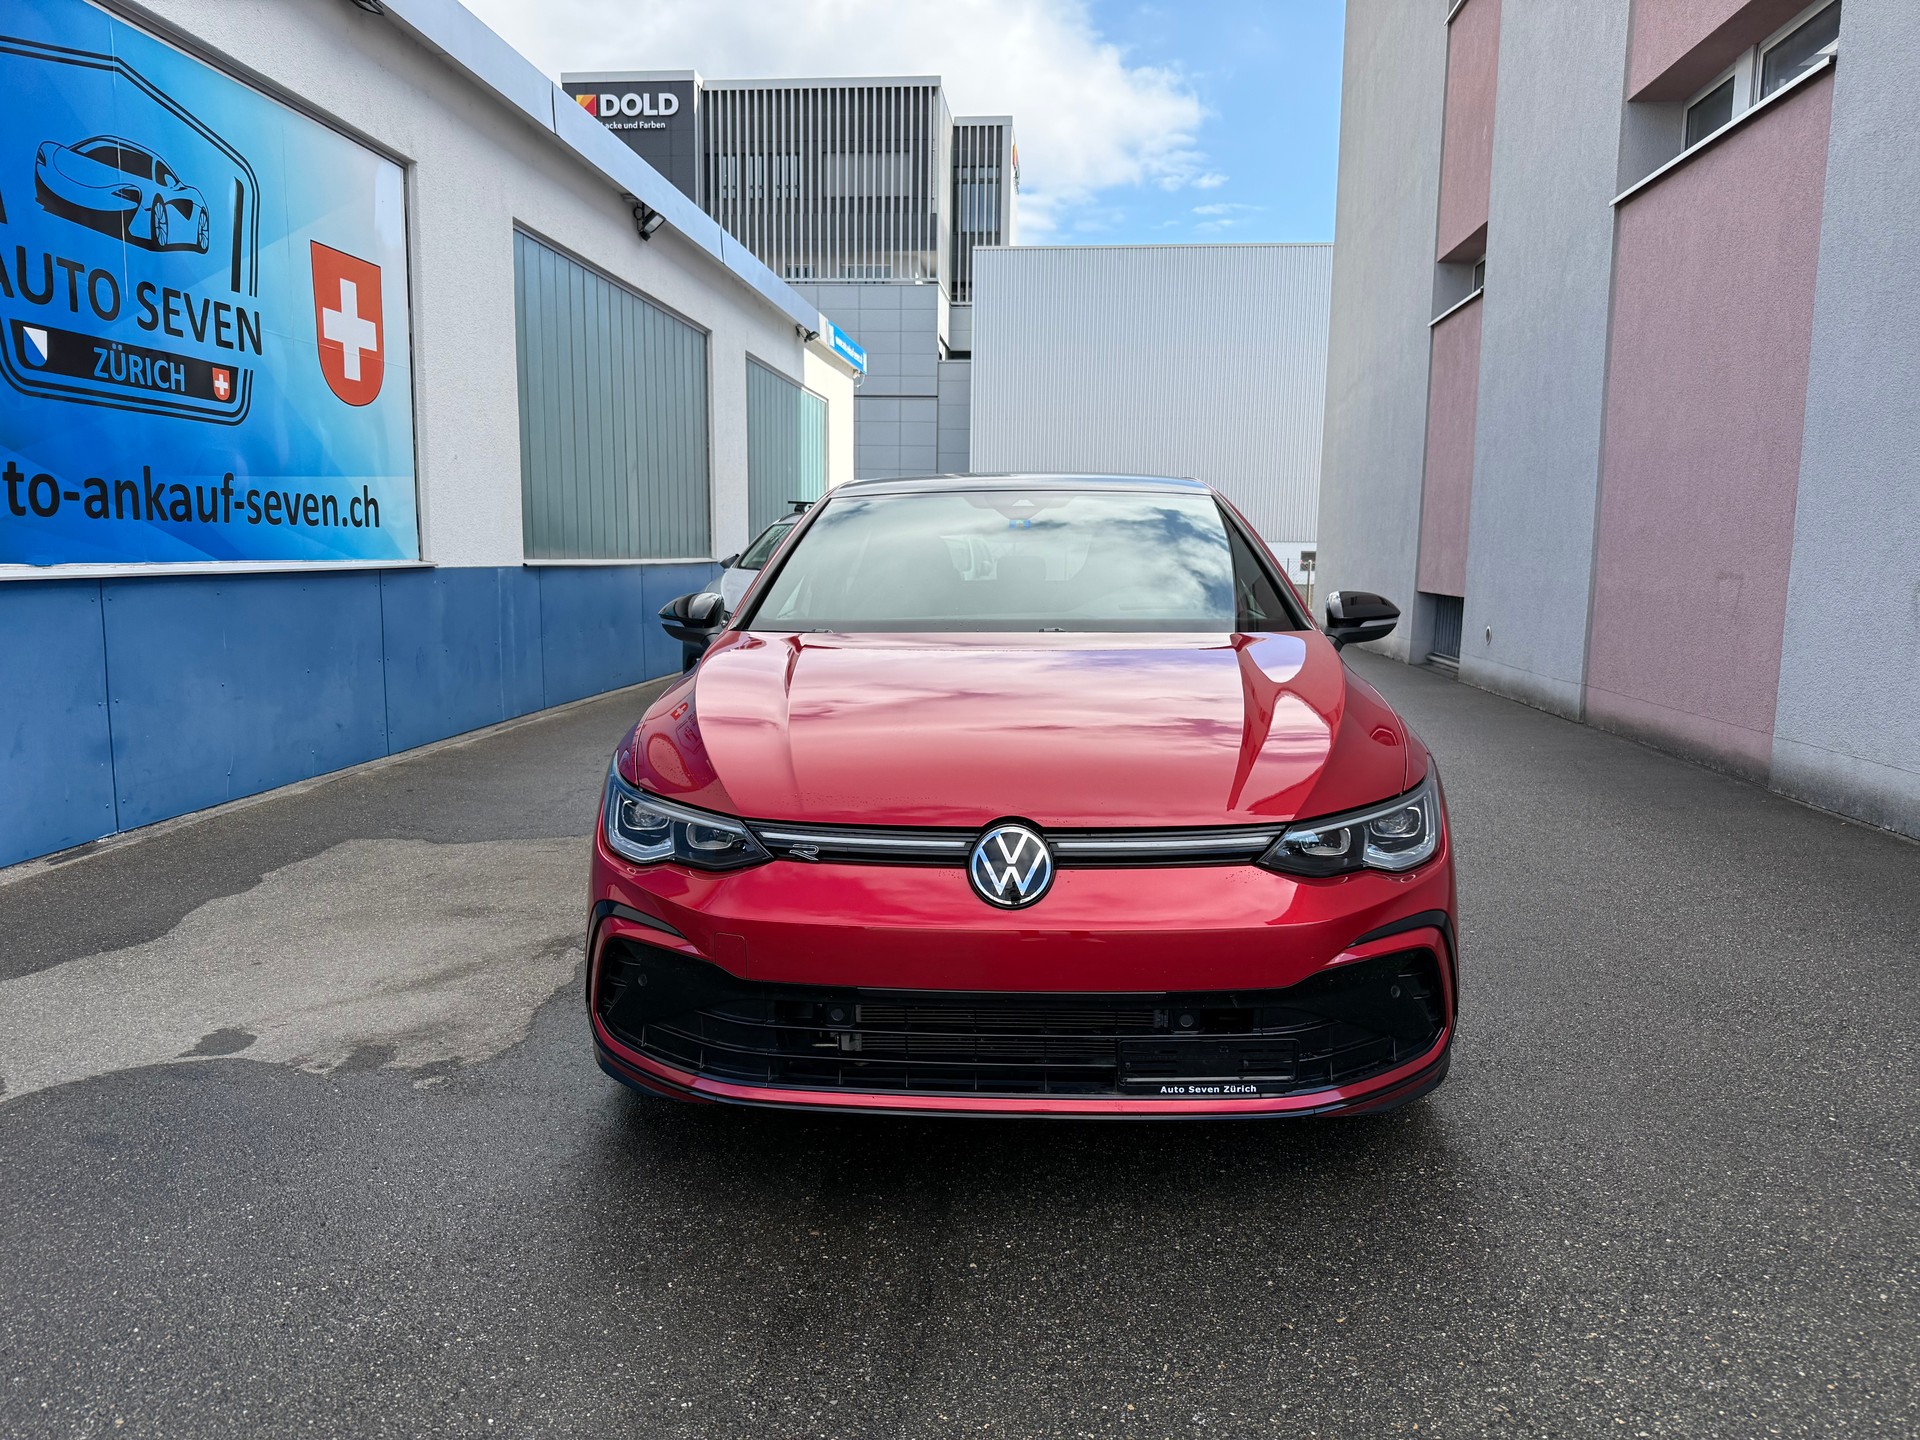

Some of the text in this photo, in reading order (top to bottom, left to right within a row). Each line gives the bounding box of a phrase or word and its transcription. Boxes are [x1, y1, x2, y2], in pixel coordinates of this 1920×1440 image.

[600, 93, 679, 117] DOLD
[600, 120, 666, 129] acke und Farben
[136, 280, 263, 356] SEVEN
[93, 343, 186, 392] ZÜRICH
[2, 460, 381, 529] to-ankauf-seven.ch
[974, 829, 1050, 899] VW
[1160, 1084, 1257, 1094] Auto Seven Zürich
